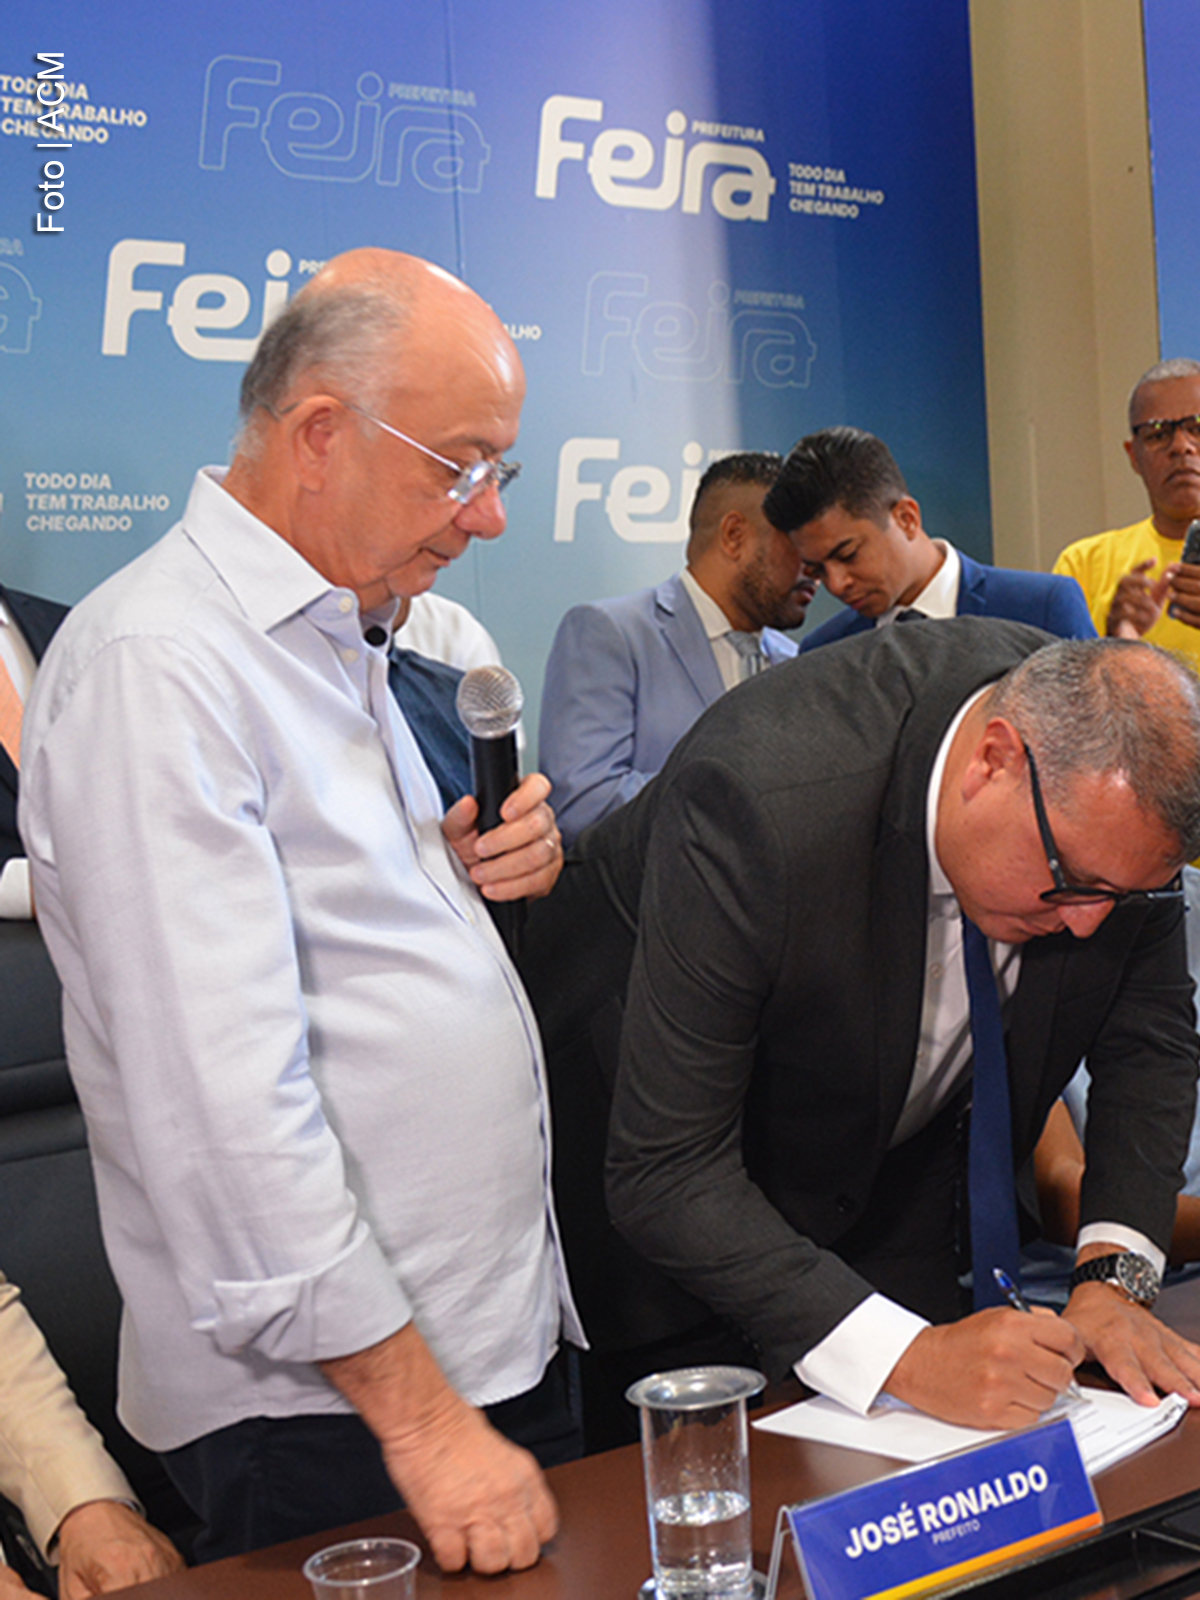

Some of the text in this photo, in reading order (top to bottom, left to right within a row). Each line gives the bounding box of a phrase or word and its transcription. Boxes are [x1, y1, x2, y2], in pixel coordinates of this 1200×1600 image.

[2, 97, 44, 116] TEM
[199, 54, 492, 194] Feira
[691, 120, 766, 142] PREFEITURA
[535, 94, 776, 222] Feira
[788, 163, 846, 183] TODO DIA
[789, 179, 885, 205] TEM TRABALHO
[789, 197, 860, 219] CHEGANDO
[102, 238, 292, 362] Fei
[581, 271, 818, 389] Feira
[24, 472, 112, 490] TODO DIA
[25, 493, 170, 512] TEM TRABALHO
[26, 515, 133, 532] CHEGANDO
[845, 1464, 1049, 1559] JOSÉ RONALDO
[932, 1518, 981, 1545] PREFEITO
